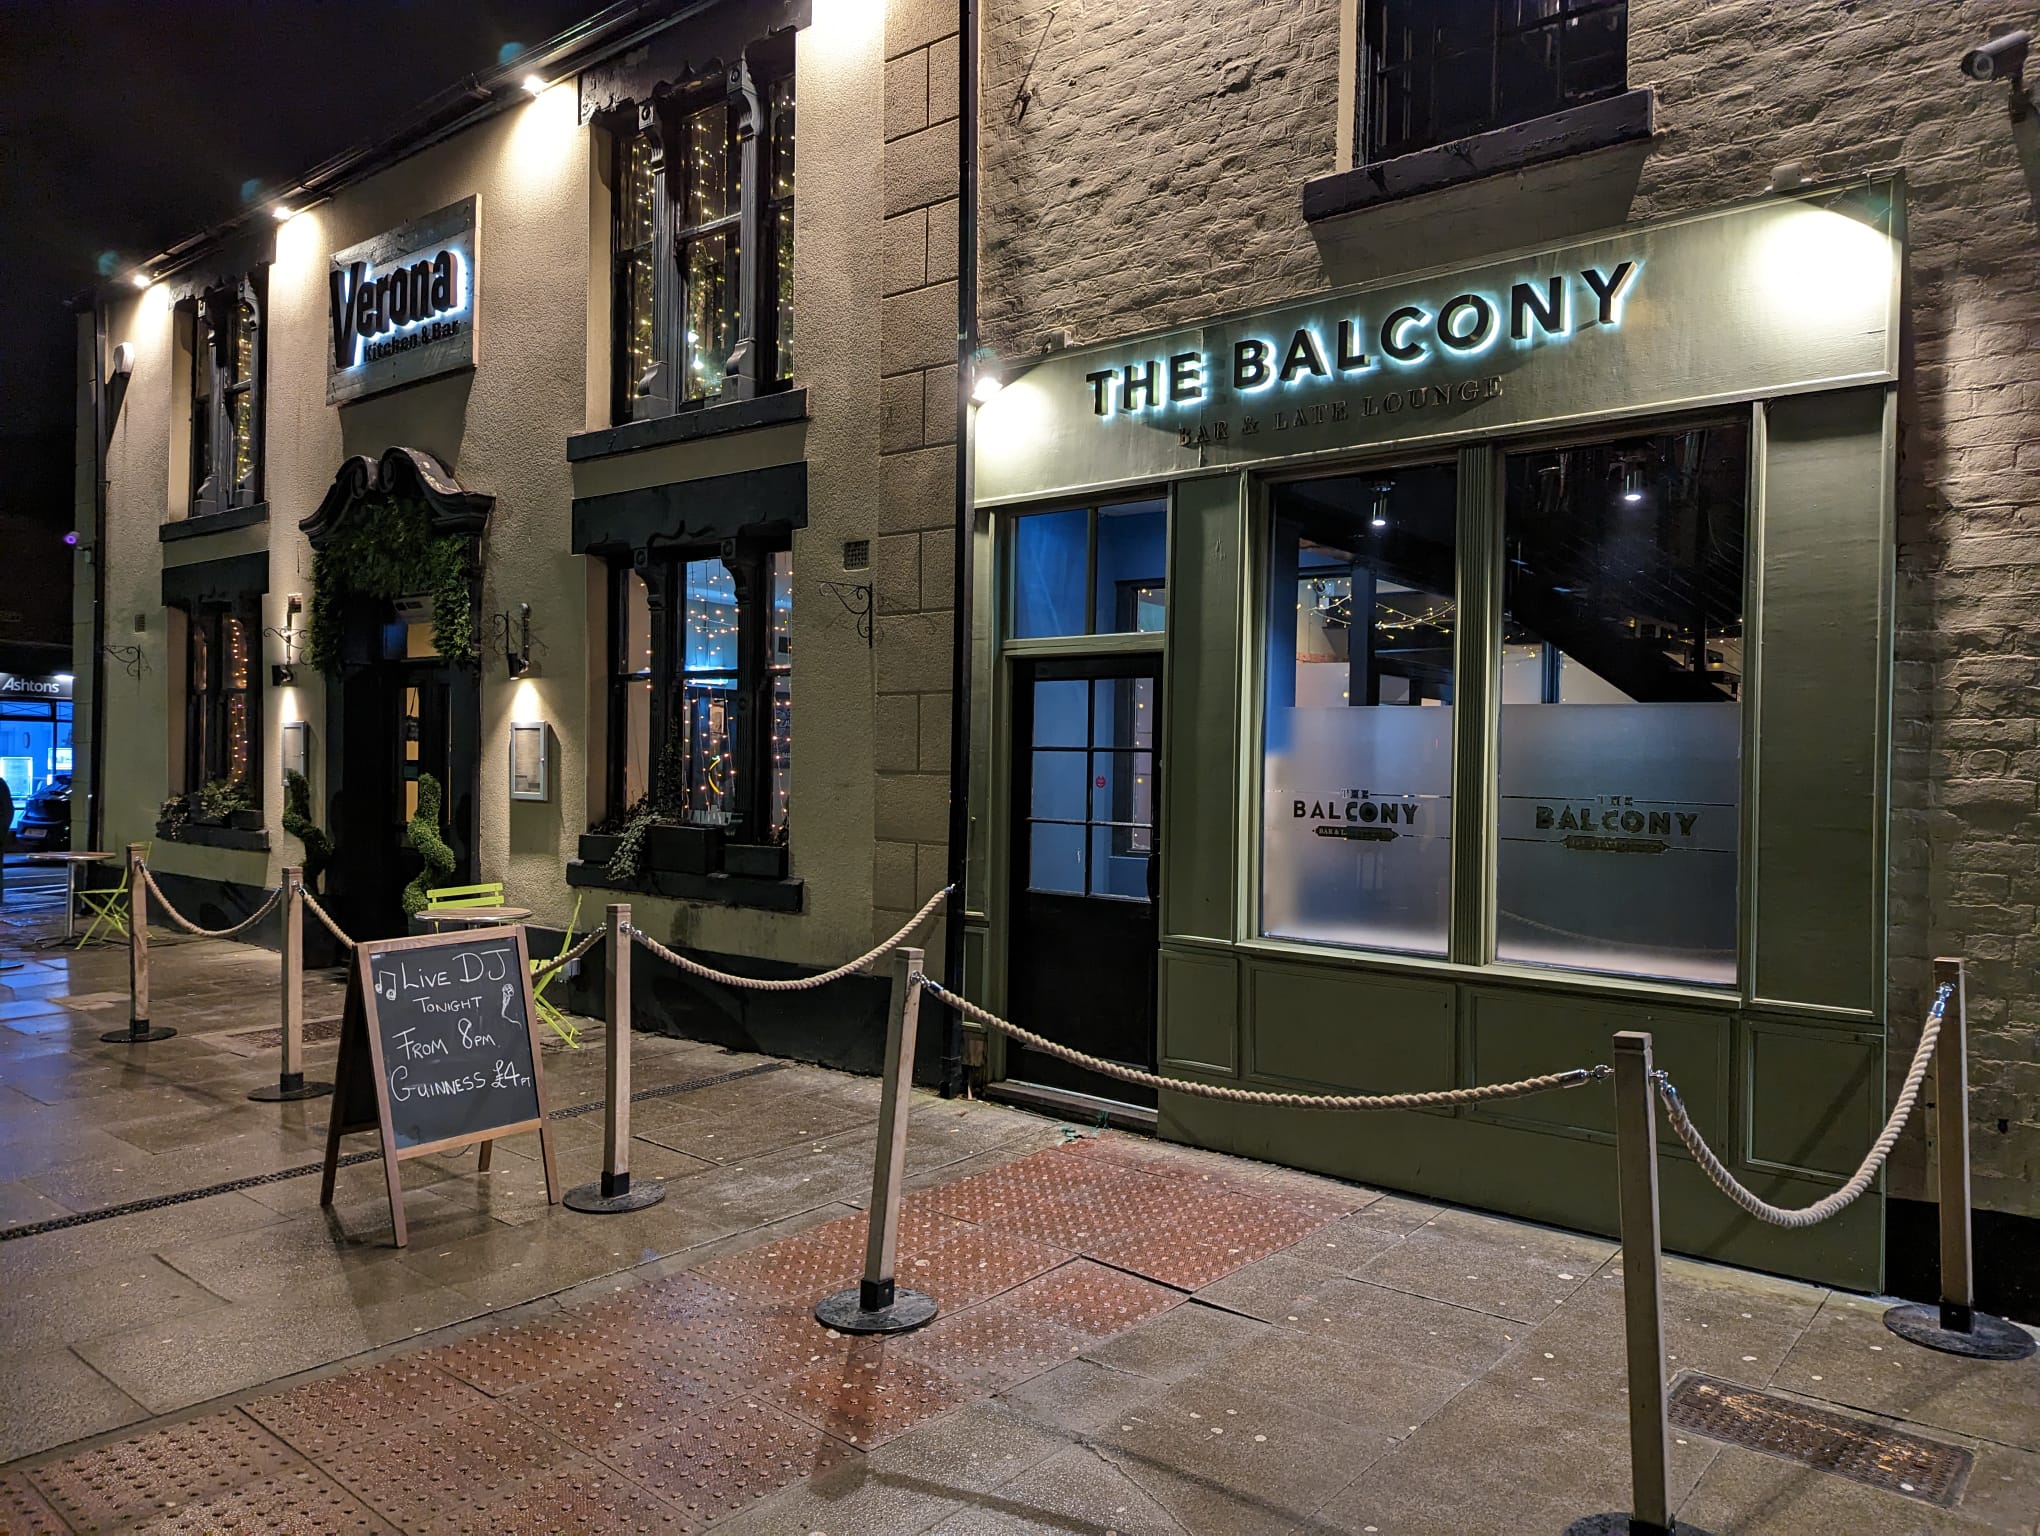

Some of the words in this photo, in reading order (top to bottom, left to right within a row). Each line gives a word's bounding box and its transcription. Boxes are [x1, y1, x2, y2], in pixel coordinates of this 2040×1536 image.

[330, 250, 458, 369] Verona
[363, 333, 418, 362] Kitchen
[421, 326, 433, 345] &
[432, 319, 460, 341] Bar
[1085, 351, 1202, 416] THE
[1234, 261, 1639, 391] BALCONY
[1177, 421, 1230, 446] BAR
[1242, 415, 1261, 434] &
[1272, 400, 1349, 431] LATE
[1361, 376, 1504, 418] LOUNGE
[2, 676, 60, 694] Ashtons
[1342, 788, 1369, 800] THE
[1597, 794, 1634, 806] THE
[1292, 799, 1419, 825] BALCONY
[1535, 804, 1700, 837] BALCONY
[452, 948, 511, 983] DJ
[412, 996, 483, 1013] TONIGHT
[391, 1027, 449, 1060] FROM
[390, 1065, 486, 1102] GUINNESS
